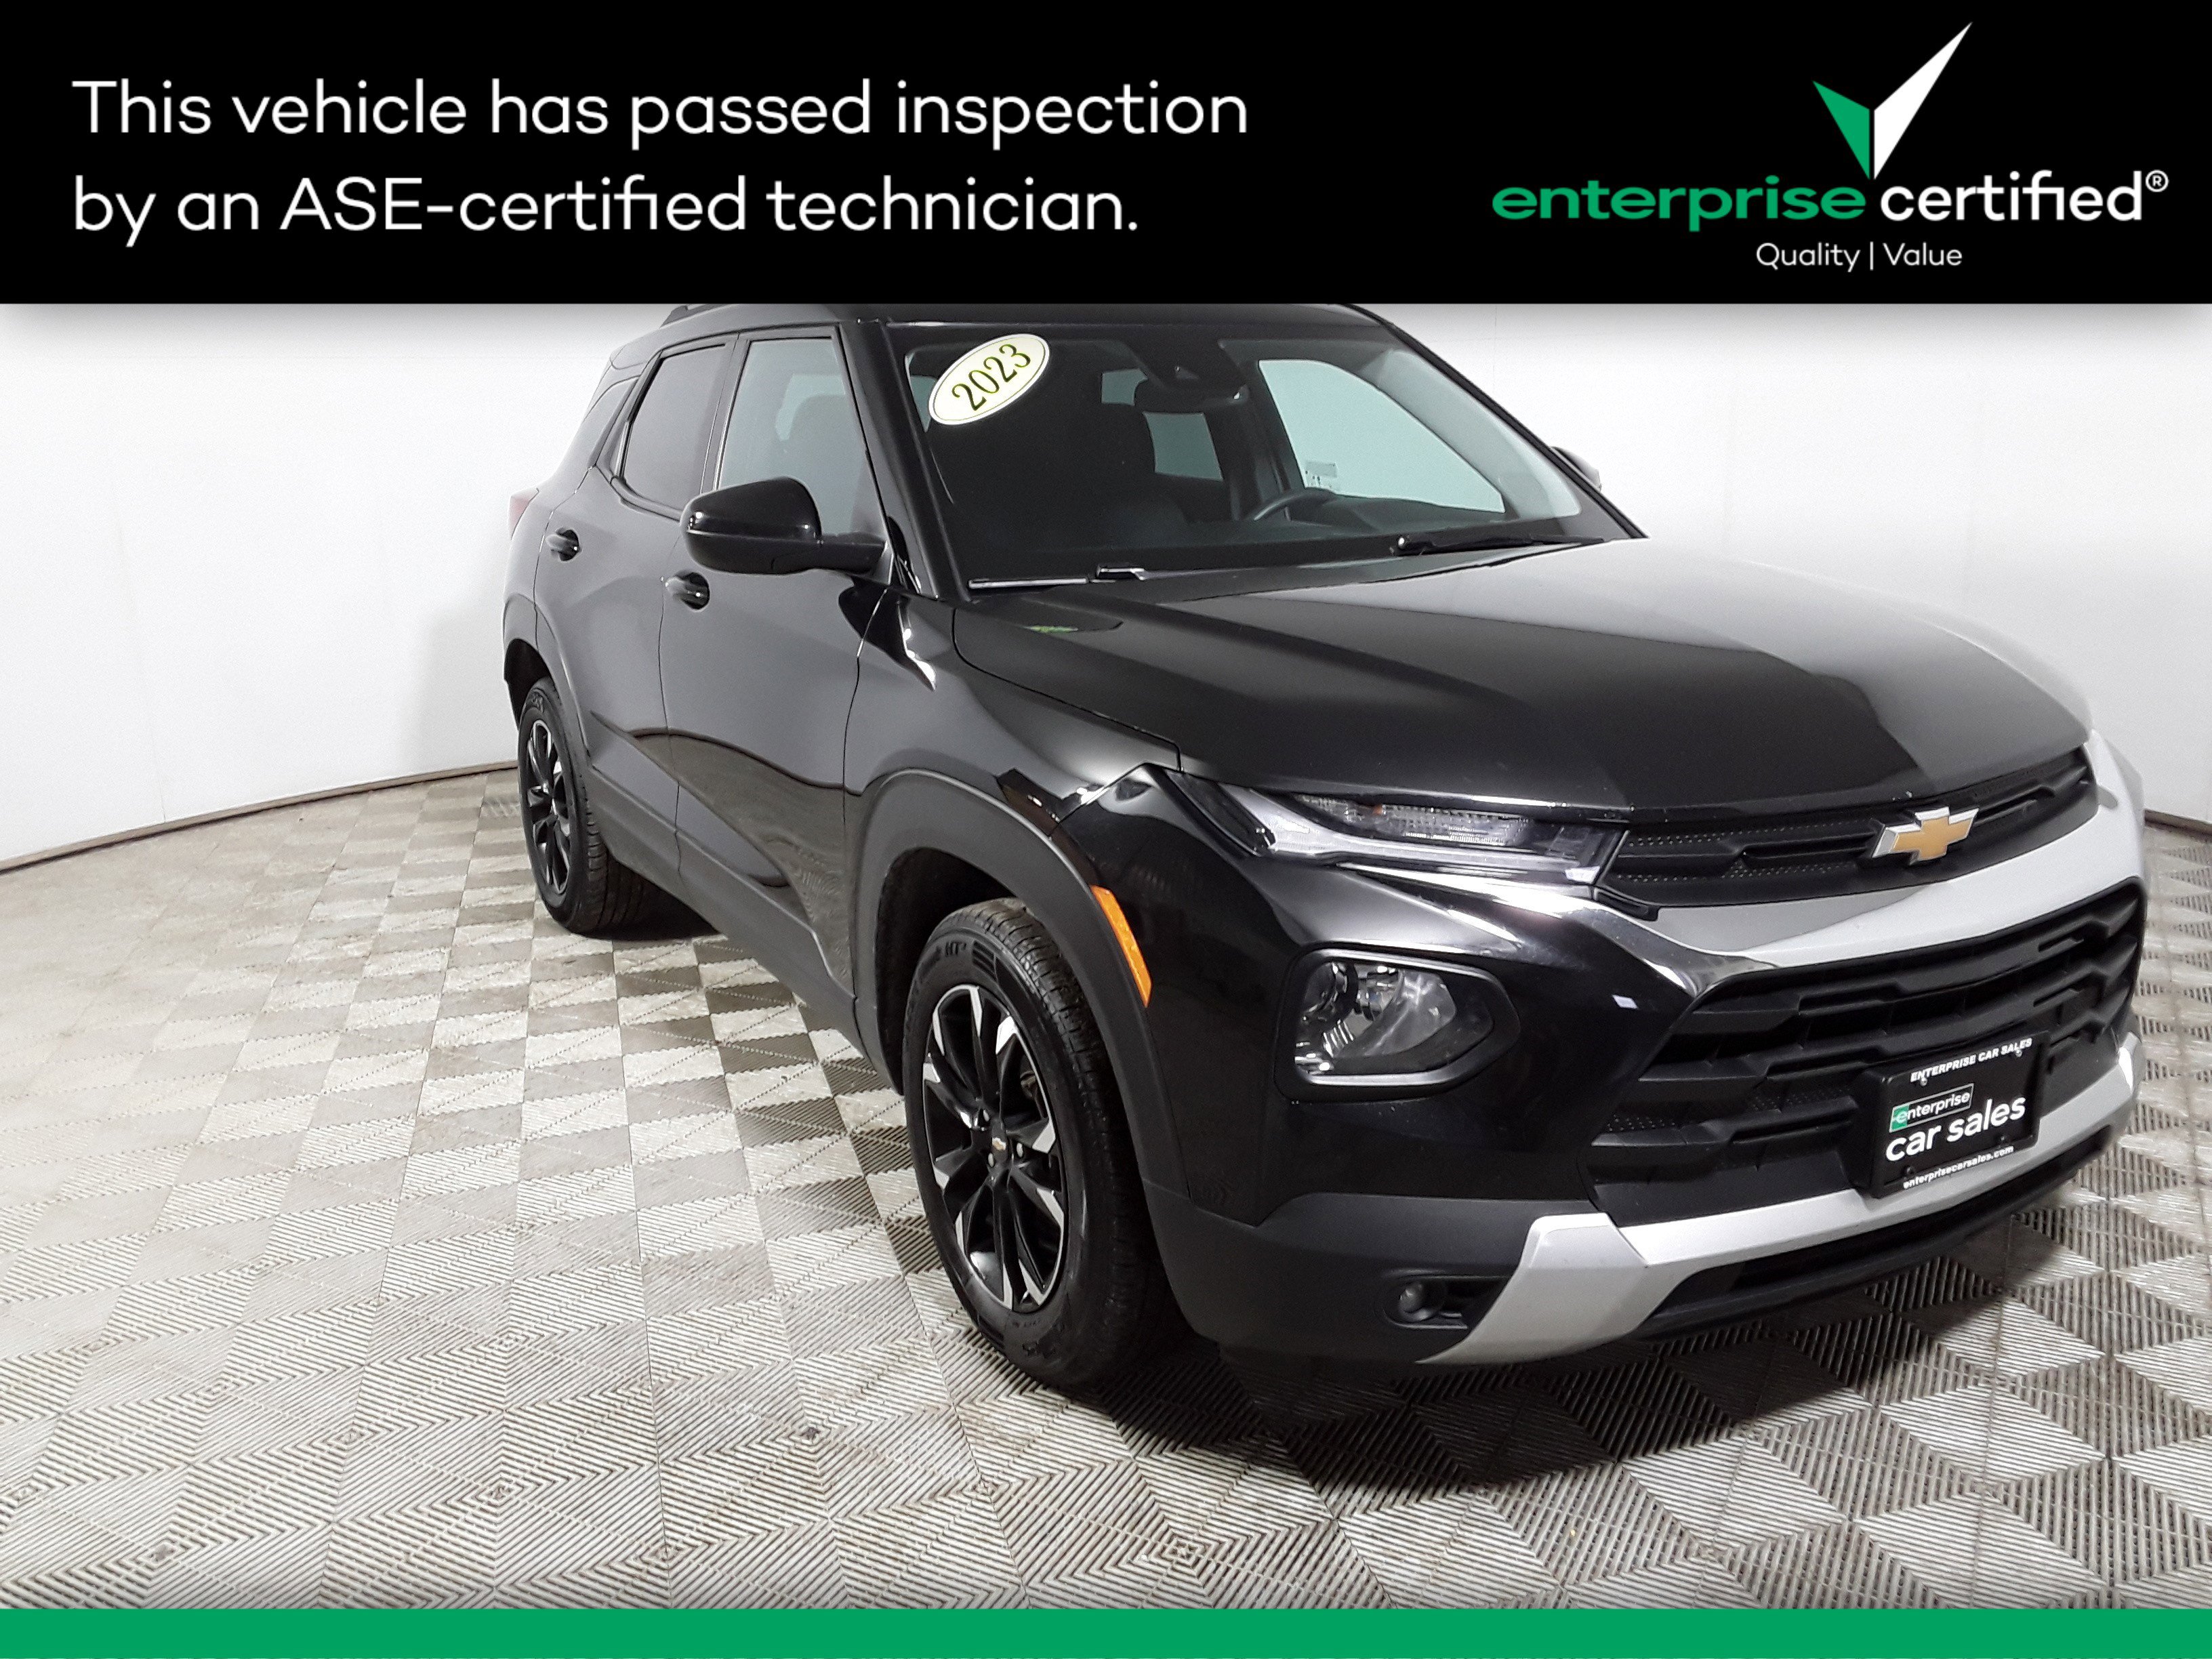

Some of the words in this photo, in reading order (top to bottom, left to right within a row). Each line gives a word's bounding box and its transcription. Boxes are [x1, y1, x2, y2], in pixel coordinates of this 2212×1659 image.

[951, 344, 1031, 411] 2023
[1910, 1054, 1976, 1083] ENTERPRISE
[1978, 1048, 1999, 1062] CAR
[2001, 1038, 2032, 1055] SALES
[1885, 1125, 1942, 1162] car
[1946, 1097, 2026, 1143] sales
[1896, 1092, 1970, 1124] enterprise
[1903, 1145, 2014, 1190] enterprisecarsales.com
